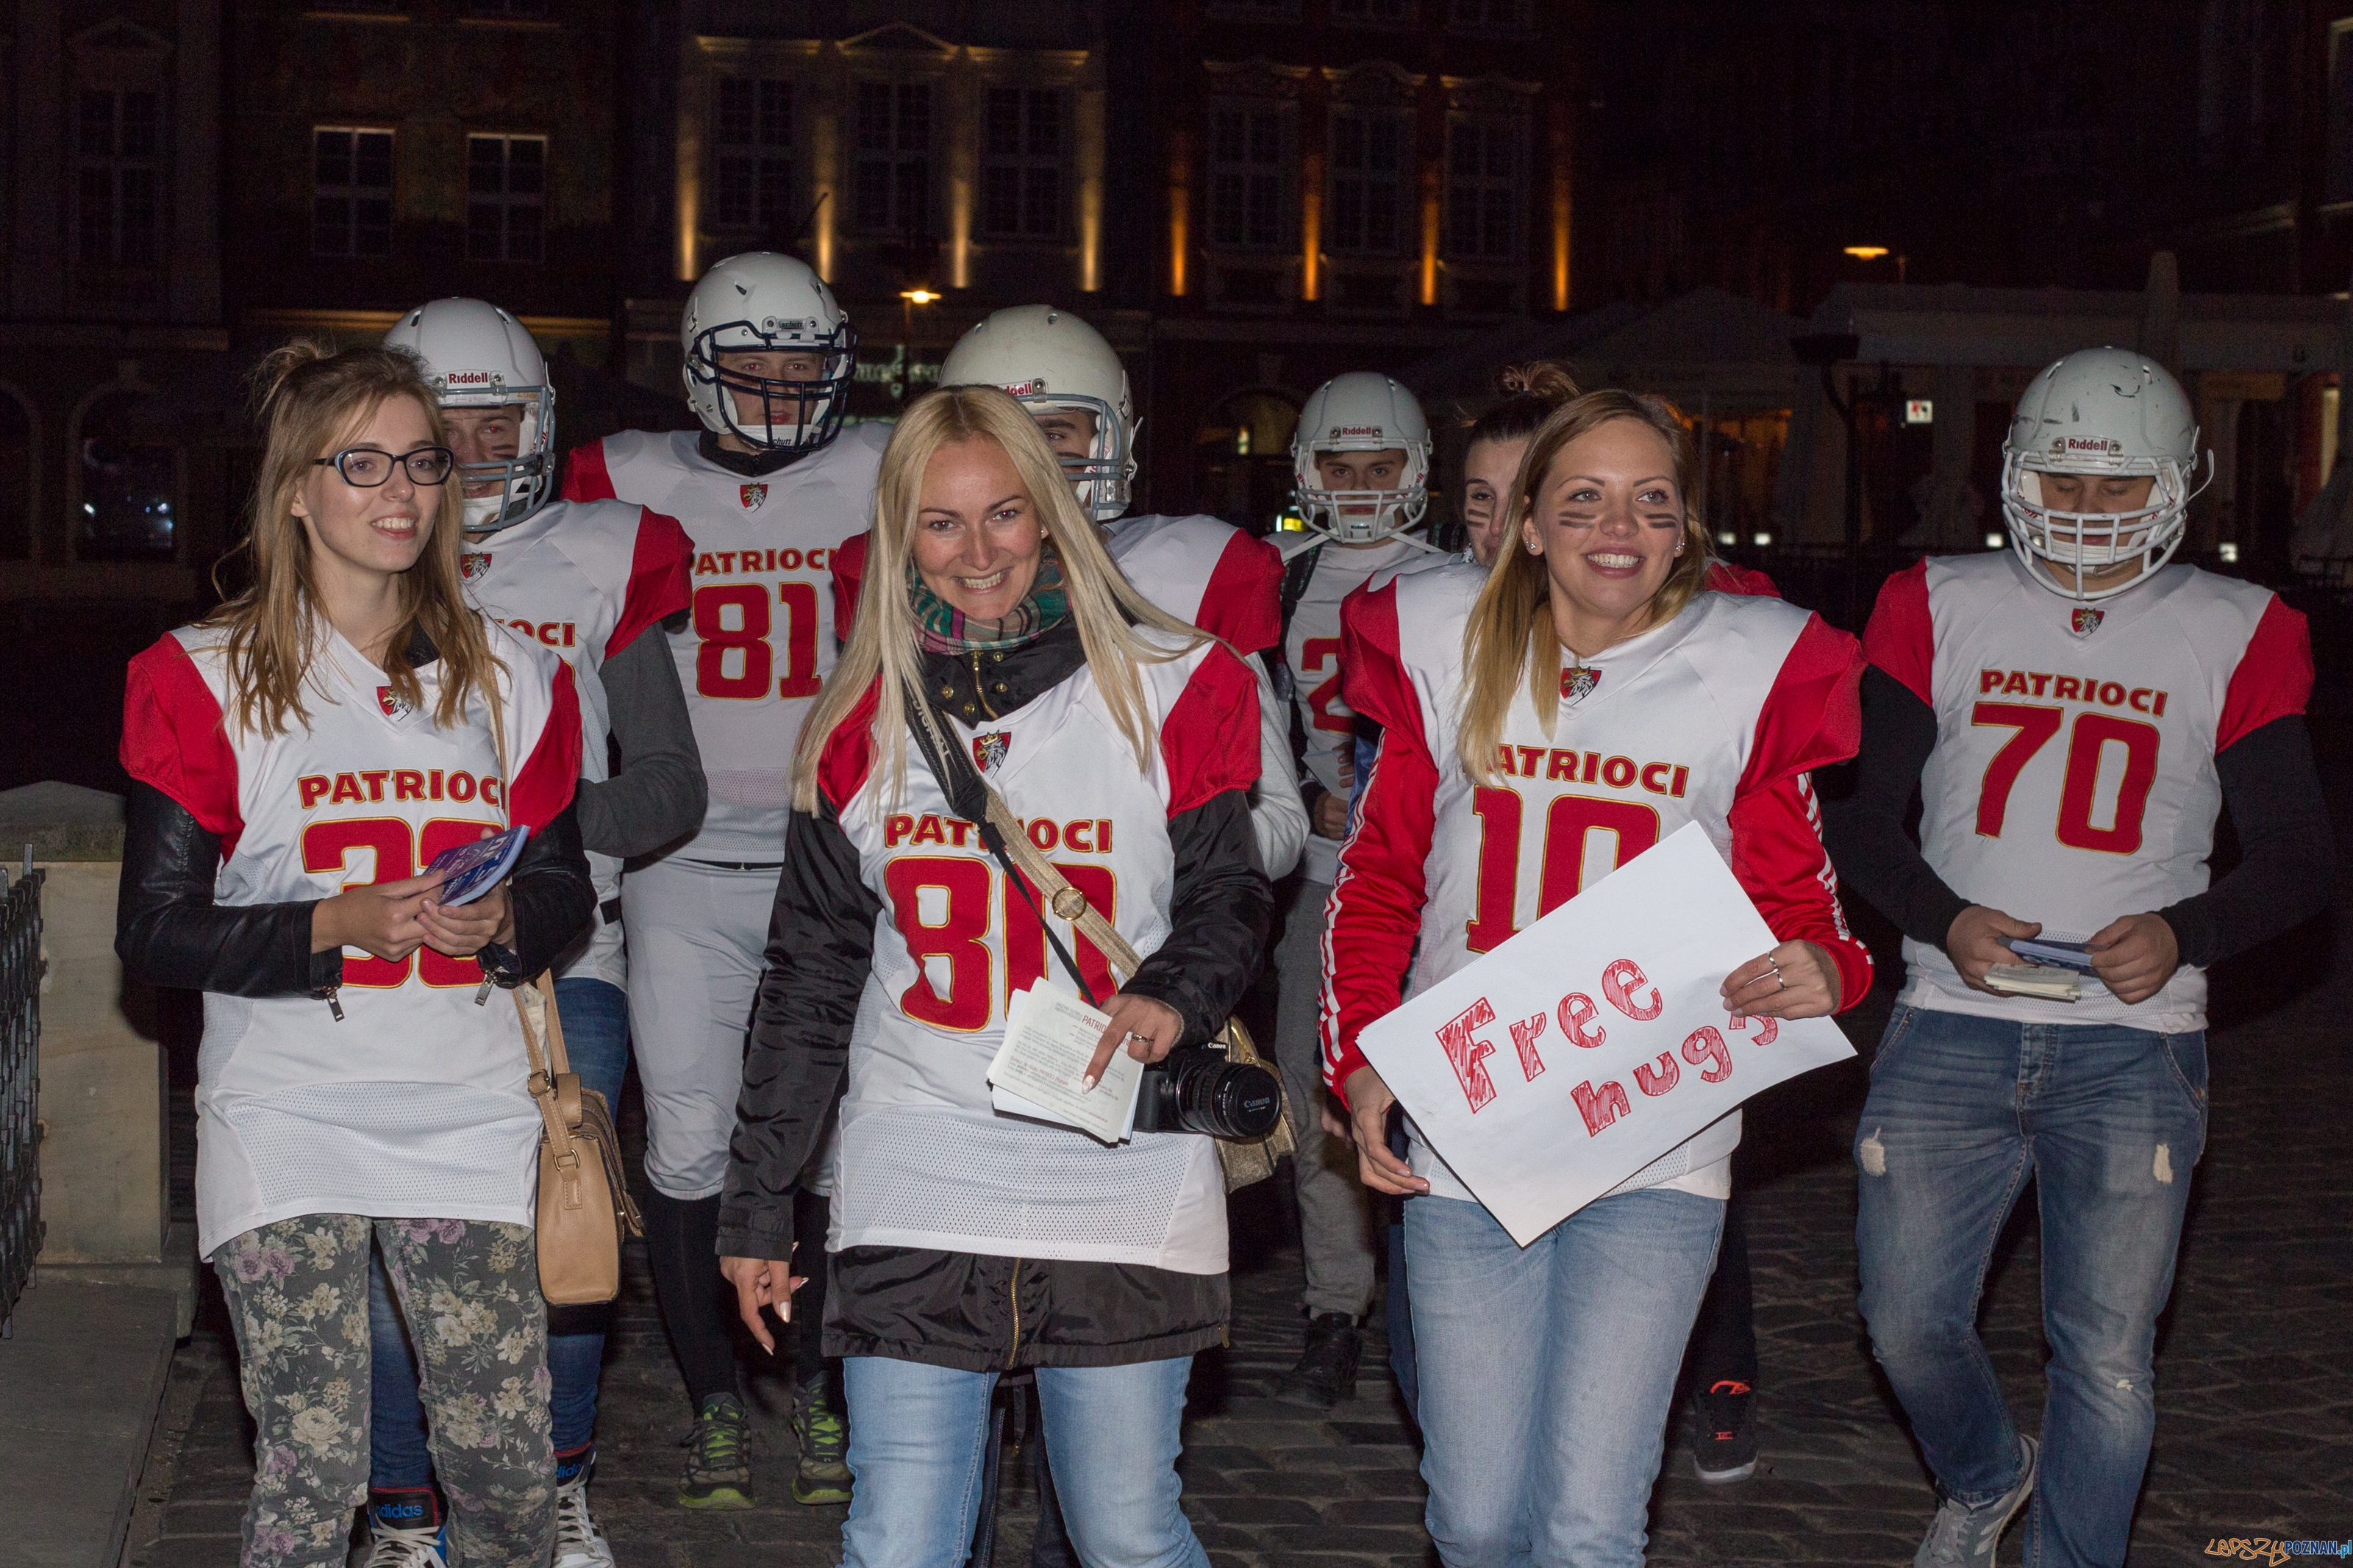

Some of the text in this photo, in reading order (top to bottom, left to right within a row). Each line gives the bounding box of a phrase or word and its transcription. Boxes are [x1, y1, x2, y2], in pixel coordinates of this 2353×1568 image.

[449, 373, 488, 384] Riddell
[1004, 382, 1032, 395] ddell
[773, 437, 791, 445] chutt
[1343, 426, 1371, 434] Riddell
[2068, 438, 2108, 451] Riddell
[690, 548, 840, 576] ATRIOCI
[691, 581, 823, 701] 81
[1980, 669, 2168, 718] PATRIOCI
[1474, 742, 1689, 798] ATRIOCI
[1971, 701, 2160, 856] 70
[884, 813, 1113, 853] PATOCI
[1466, 784, 1660, 954] 10
[883, 855, 1117, 1032] 80
[1082, 1015, 1107, 1034] PATRIO
[1435, 959, 1663, 1114] Free
[1244, 1098, 1270, 1108] Canon
[557, 1463, 583, 1478] dida
